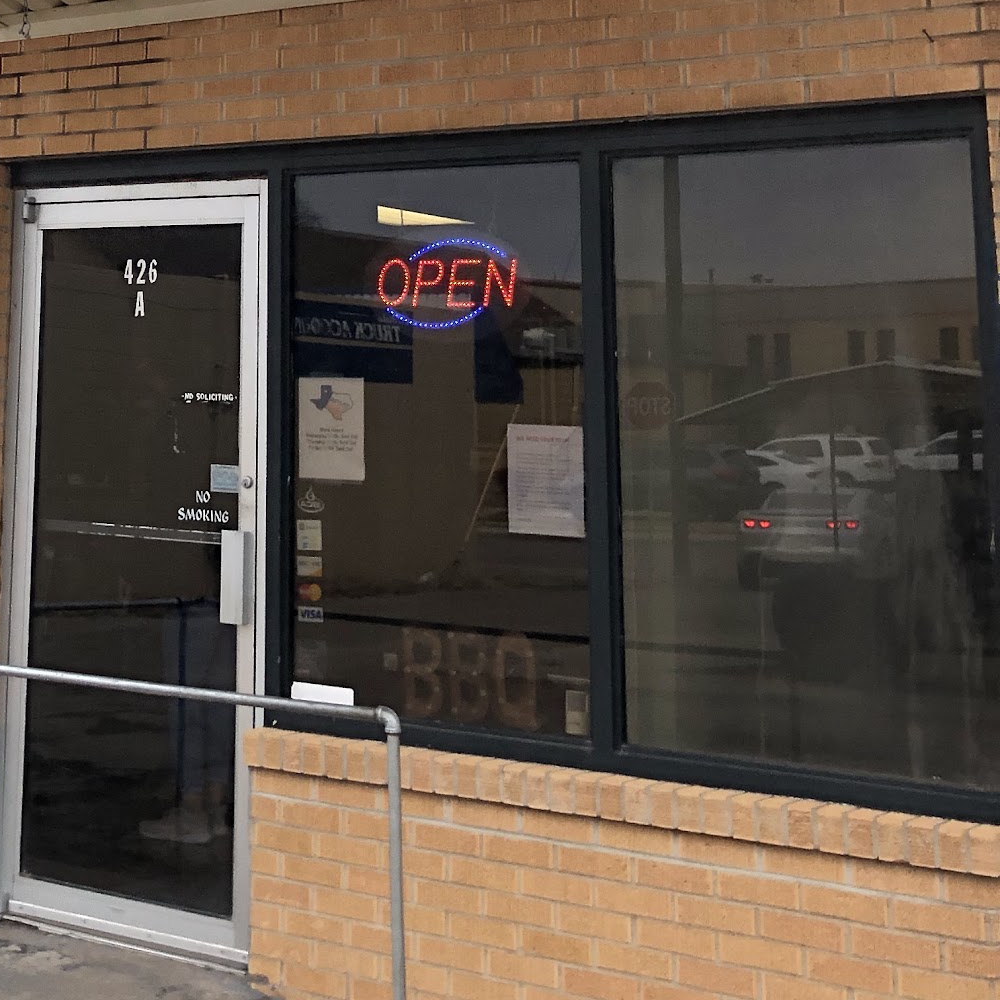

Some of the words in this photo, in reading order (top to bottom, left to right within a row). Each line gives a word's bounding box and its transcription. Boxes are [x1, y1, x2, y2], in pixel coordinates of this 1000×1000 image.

[123, 258, 158, 285] 426
[376, 257, 519, 309] OPEN
[134, 291, 145, 317] A
[184, 392, 194, 401] NO
[196, 392, 235, 402] SOLICITING
[195, 490, 211, 504] NO
[177, 507, 230, 524] SMOKING
[300, 609, 322, 620] VISA
